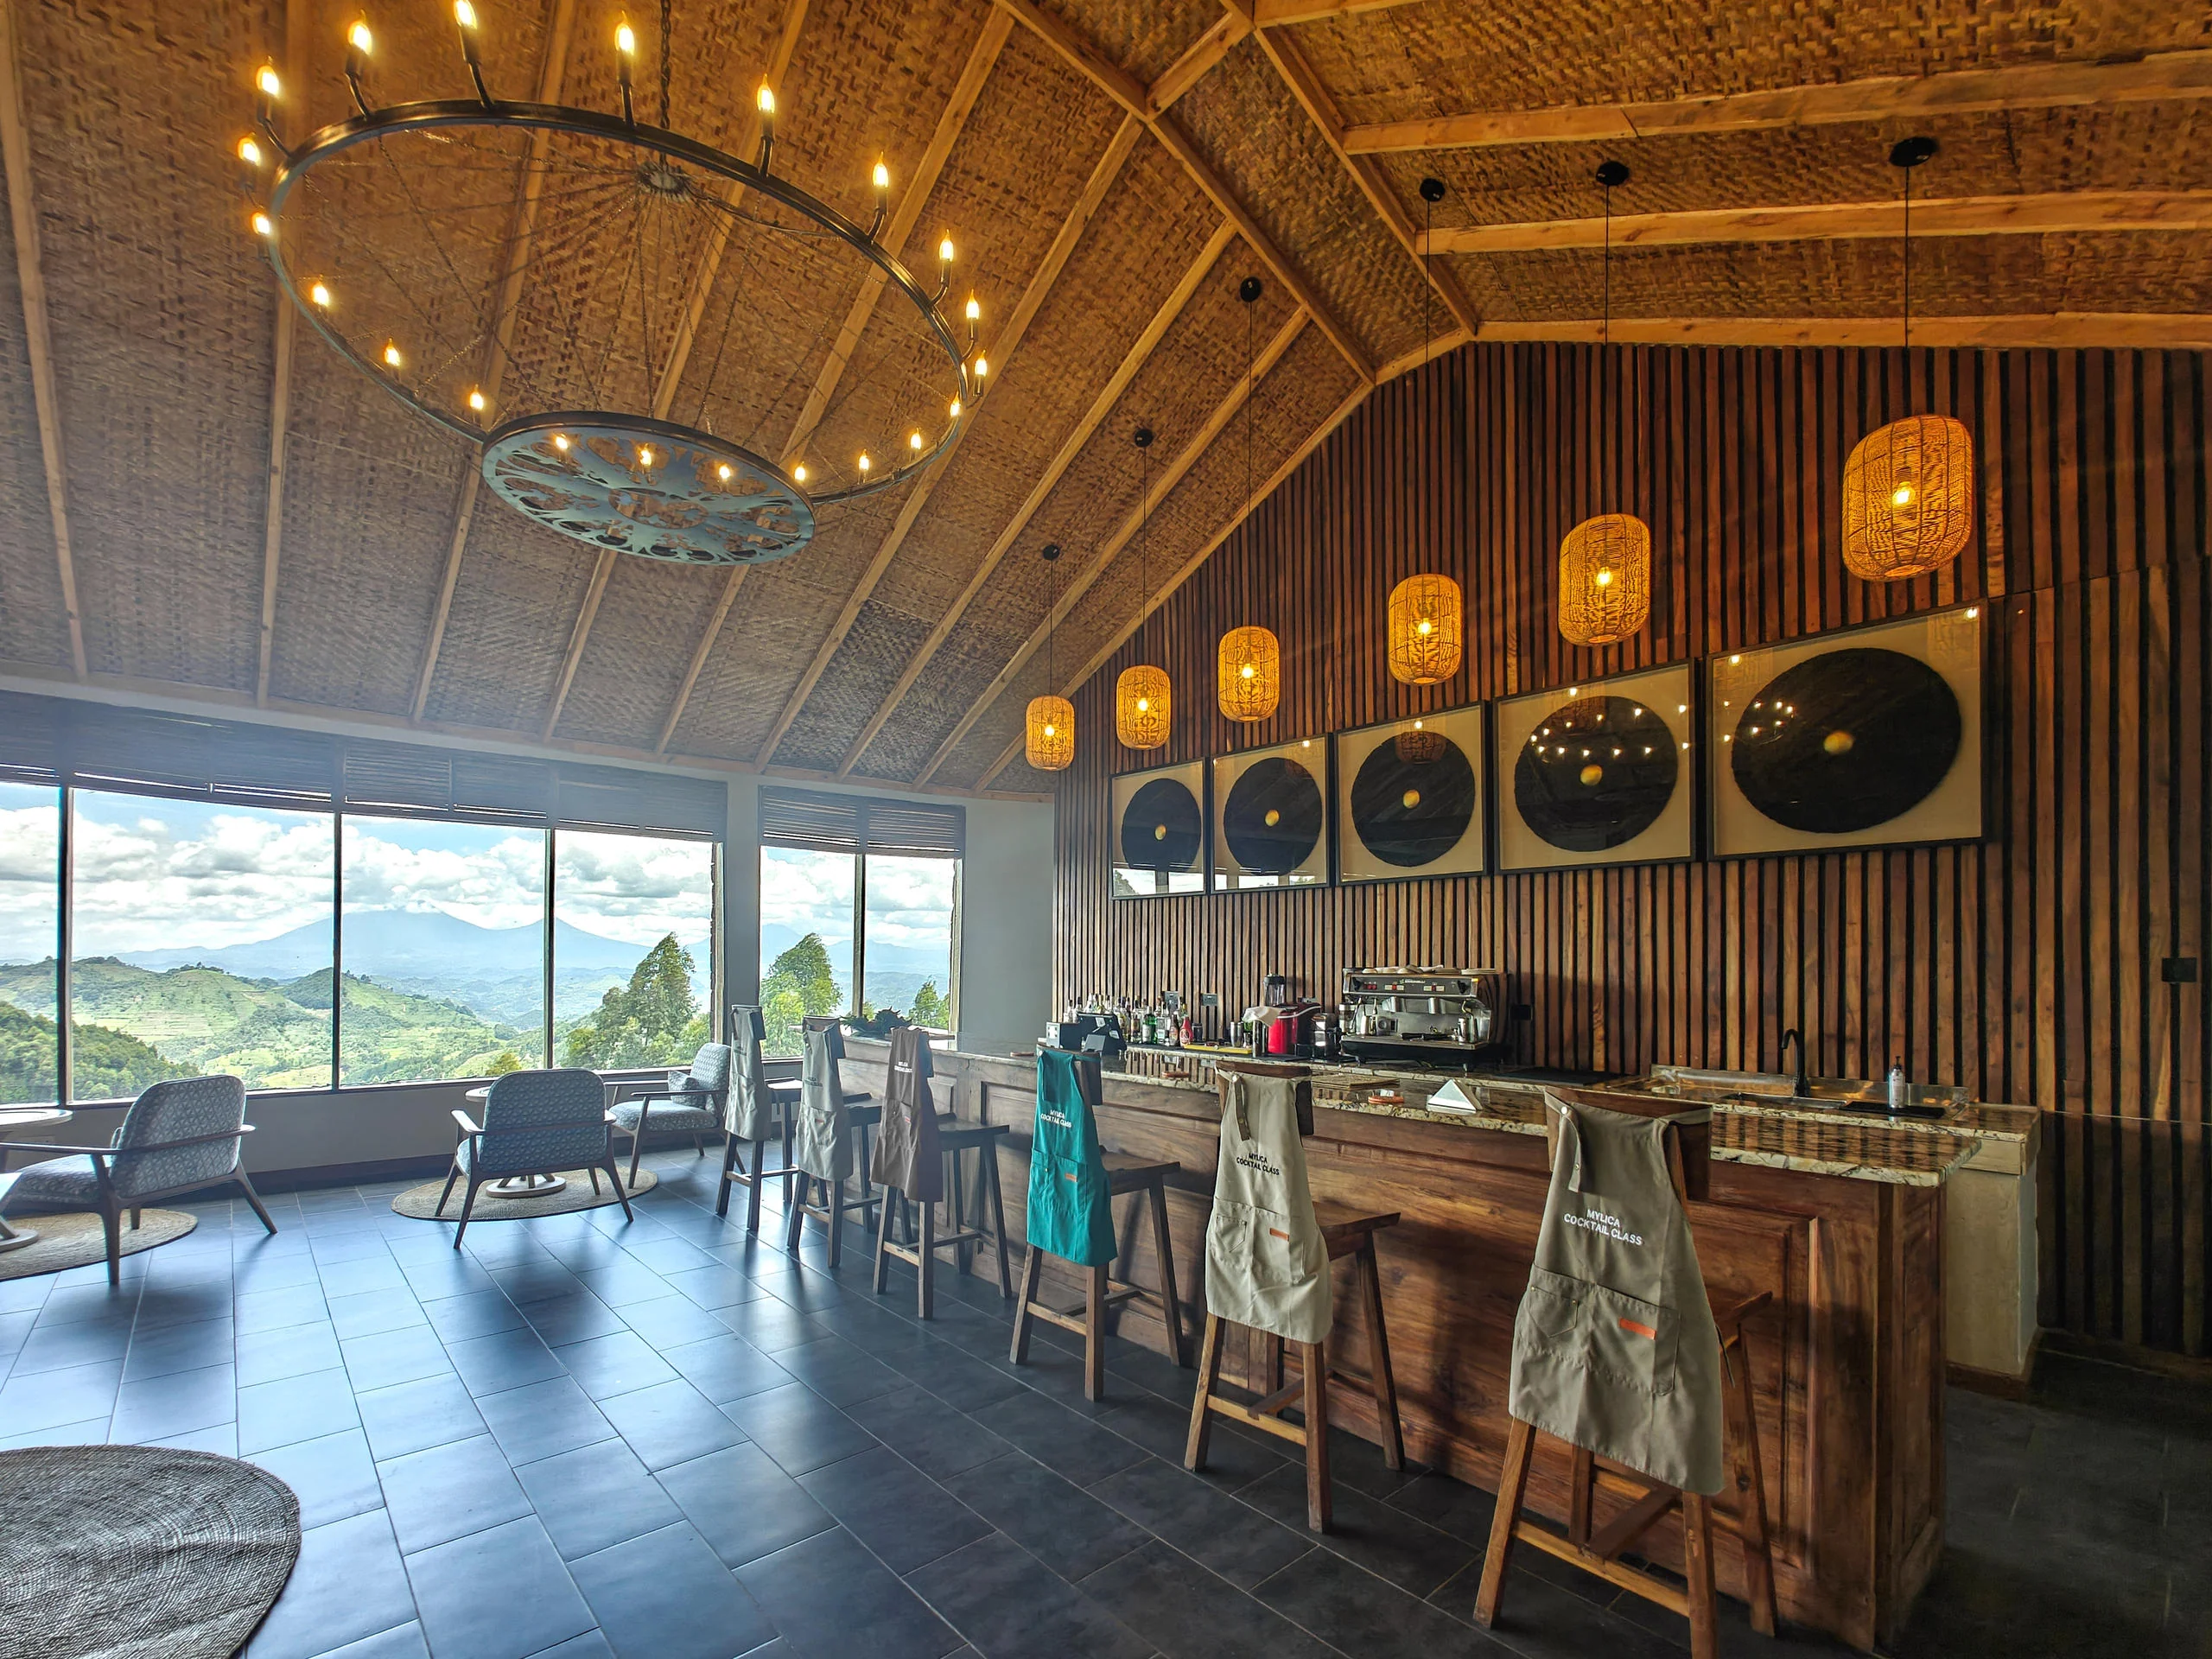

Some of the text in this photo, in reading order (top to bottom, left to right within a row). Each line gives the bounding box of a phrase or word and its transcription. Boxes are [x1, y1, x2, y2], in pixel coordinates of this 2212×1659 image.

[1236, 1157, 1280, 1175] COCKTAIL CLASS
[1586, 1209, 1620, 1227] MYLICA
[1563, 1213, 1643, 1245] COCKTAIL CLASS
